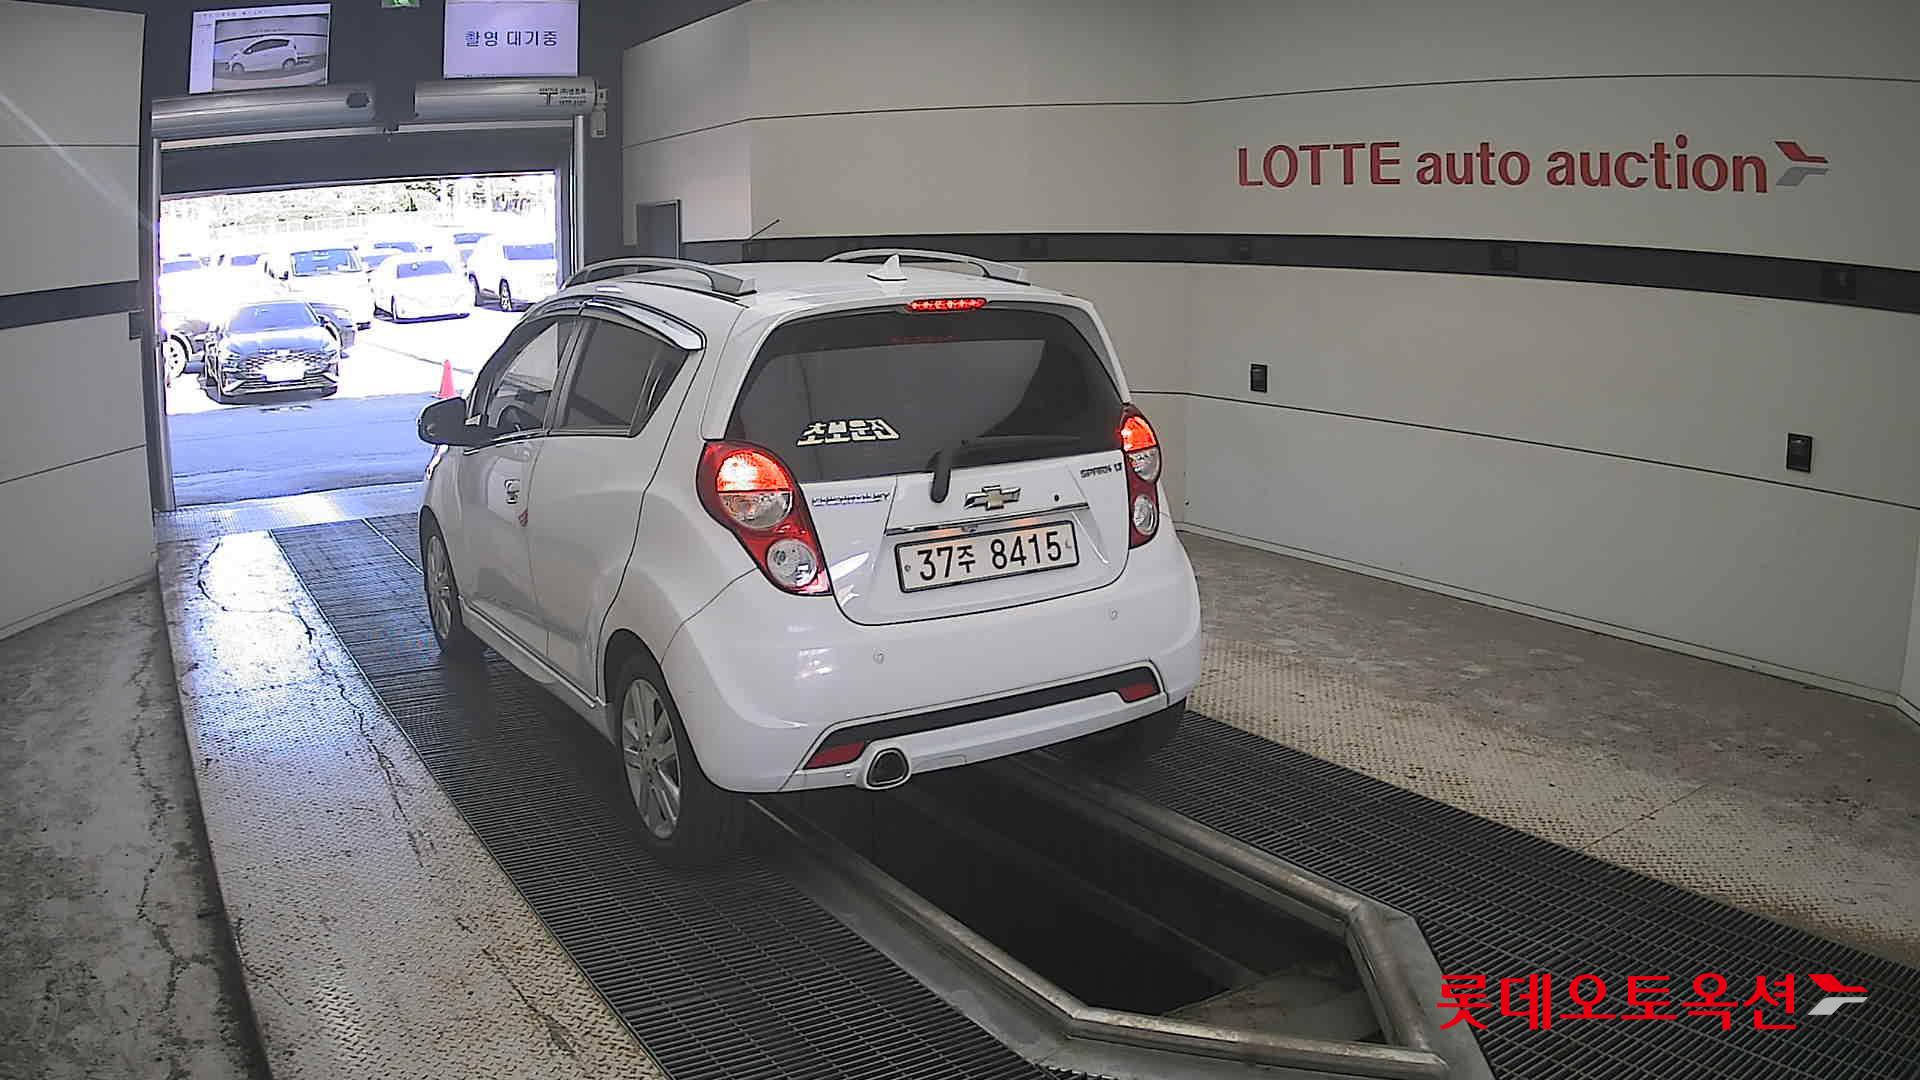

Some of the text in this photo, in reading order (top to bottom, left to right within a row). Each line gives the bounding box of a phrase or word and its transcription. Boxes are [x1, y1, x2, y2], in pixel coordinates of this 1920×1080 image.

[506, 30, 558, 47] 대기중
[1238, 134, 1768, 193] LOTTE auto auction
[917, 530, 1062, 581] 37주 8415
